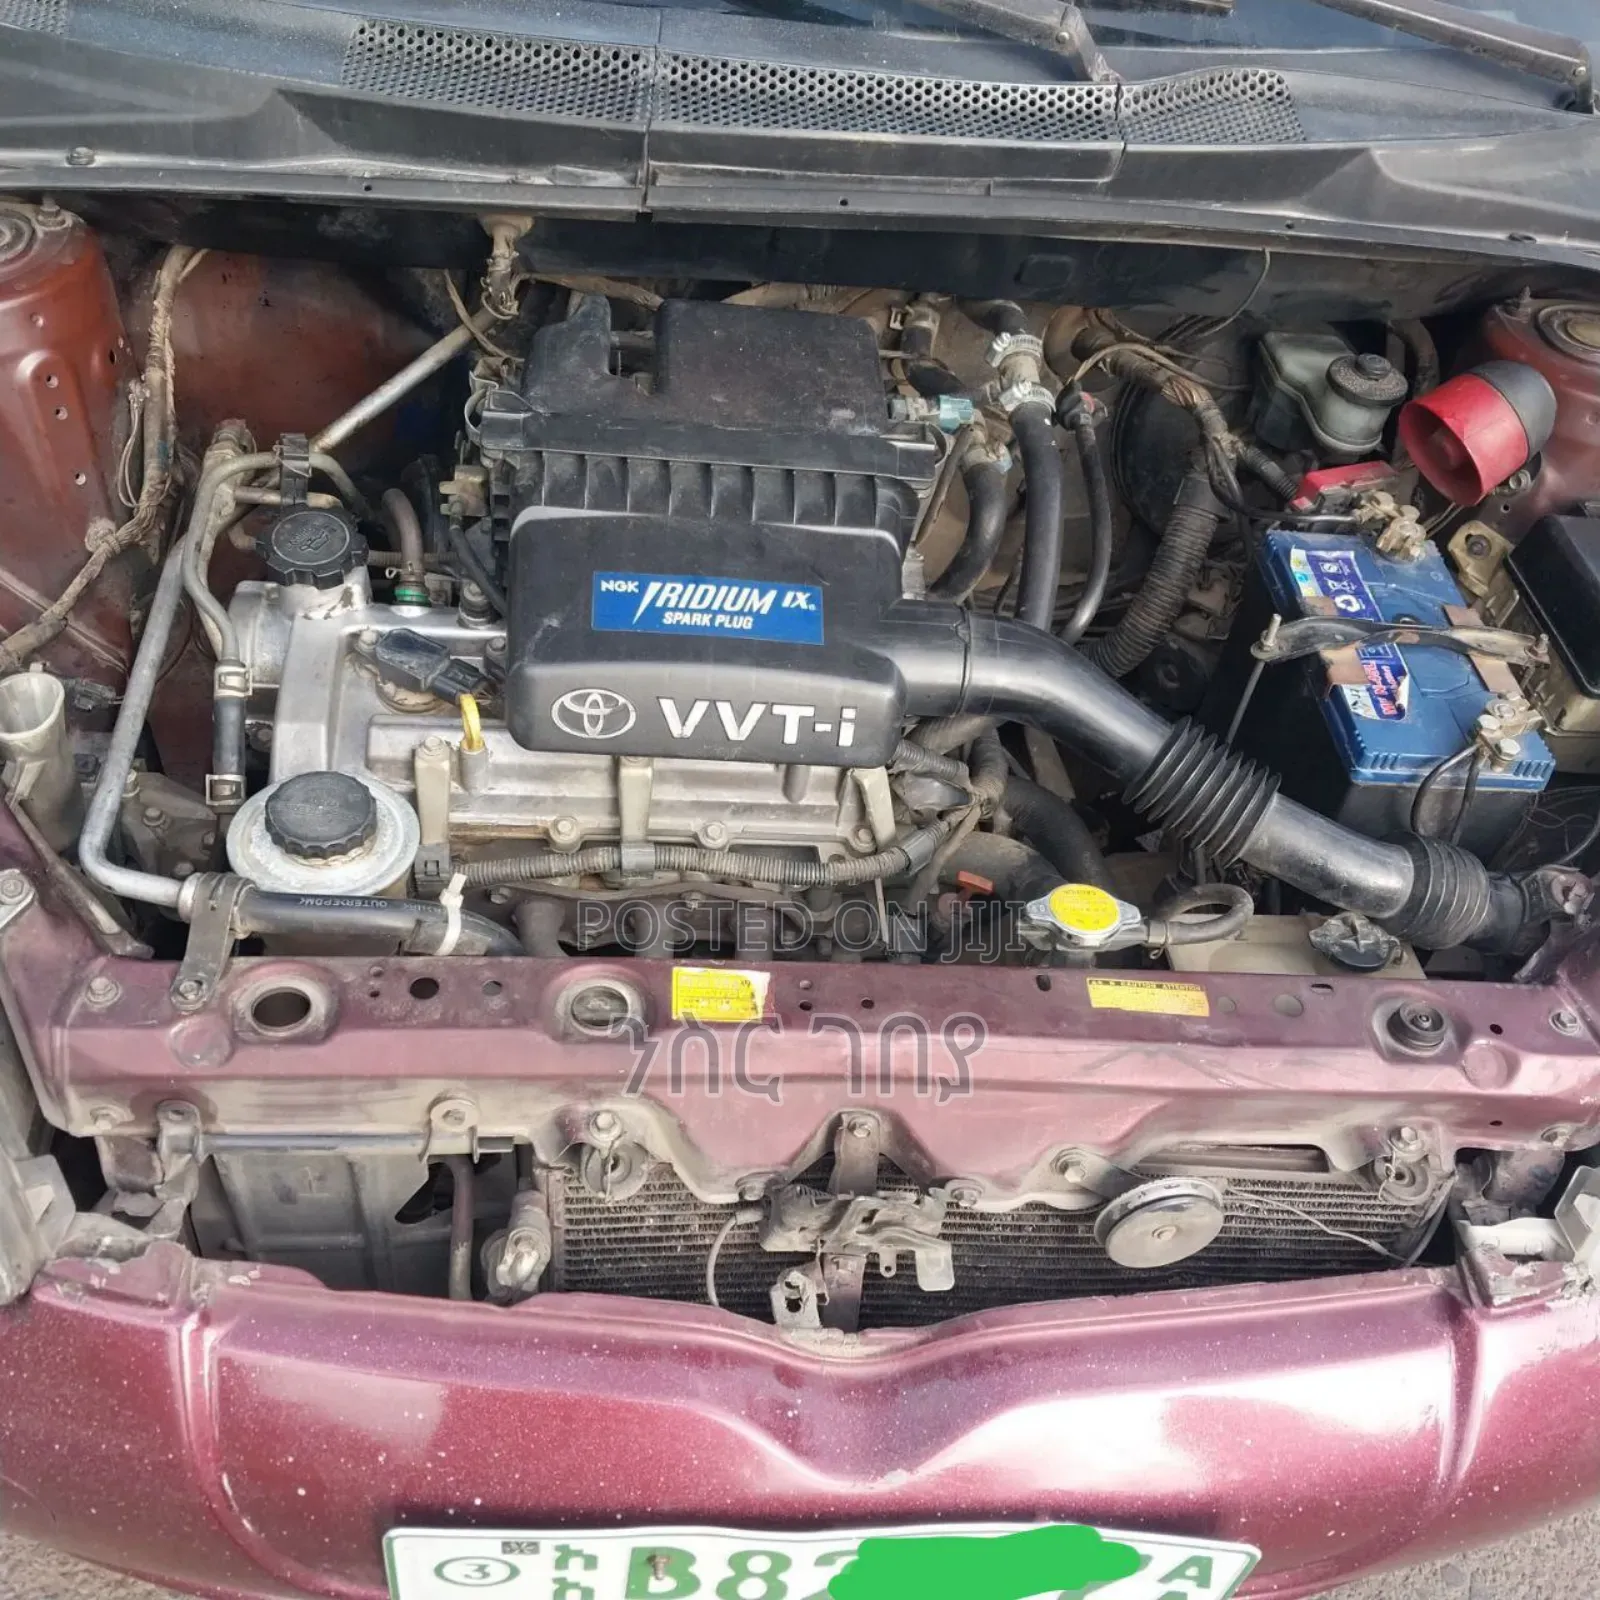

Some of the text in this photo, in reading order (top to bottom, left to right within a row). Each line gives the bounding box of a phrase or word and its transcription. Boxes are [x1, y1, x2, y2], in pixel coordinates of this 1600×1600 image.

[600, 579, 639, 593] NGK
[632, 581, 778, 625] IRIDIUM
[663, 611, 753, 630] SPARK PLUG
[656, 697, 858, 747] VVT-i
[463, 1563, 492, 1581] 3
